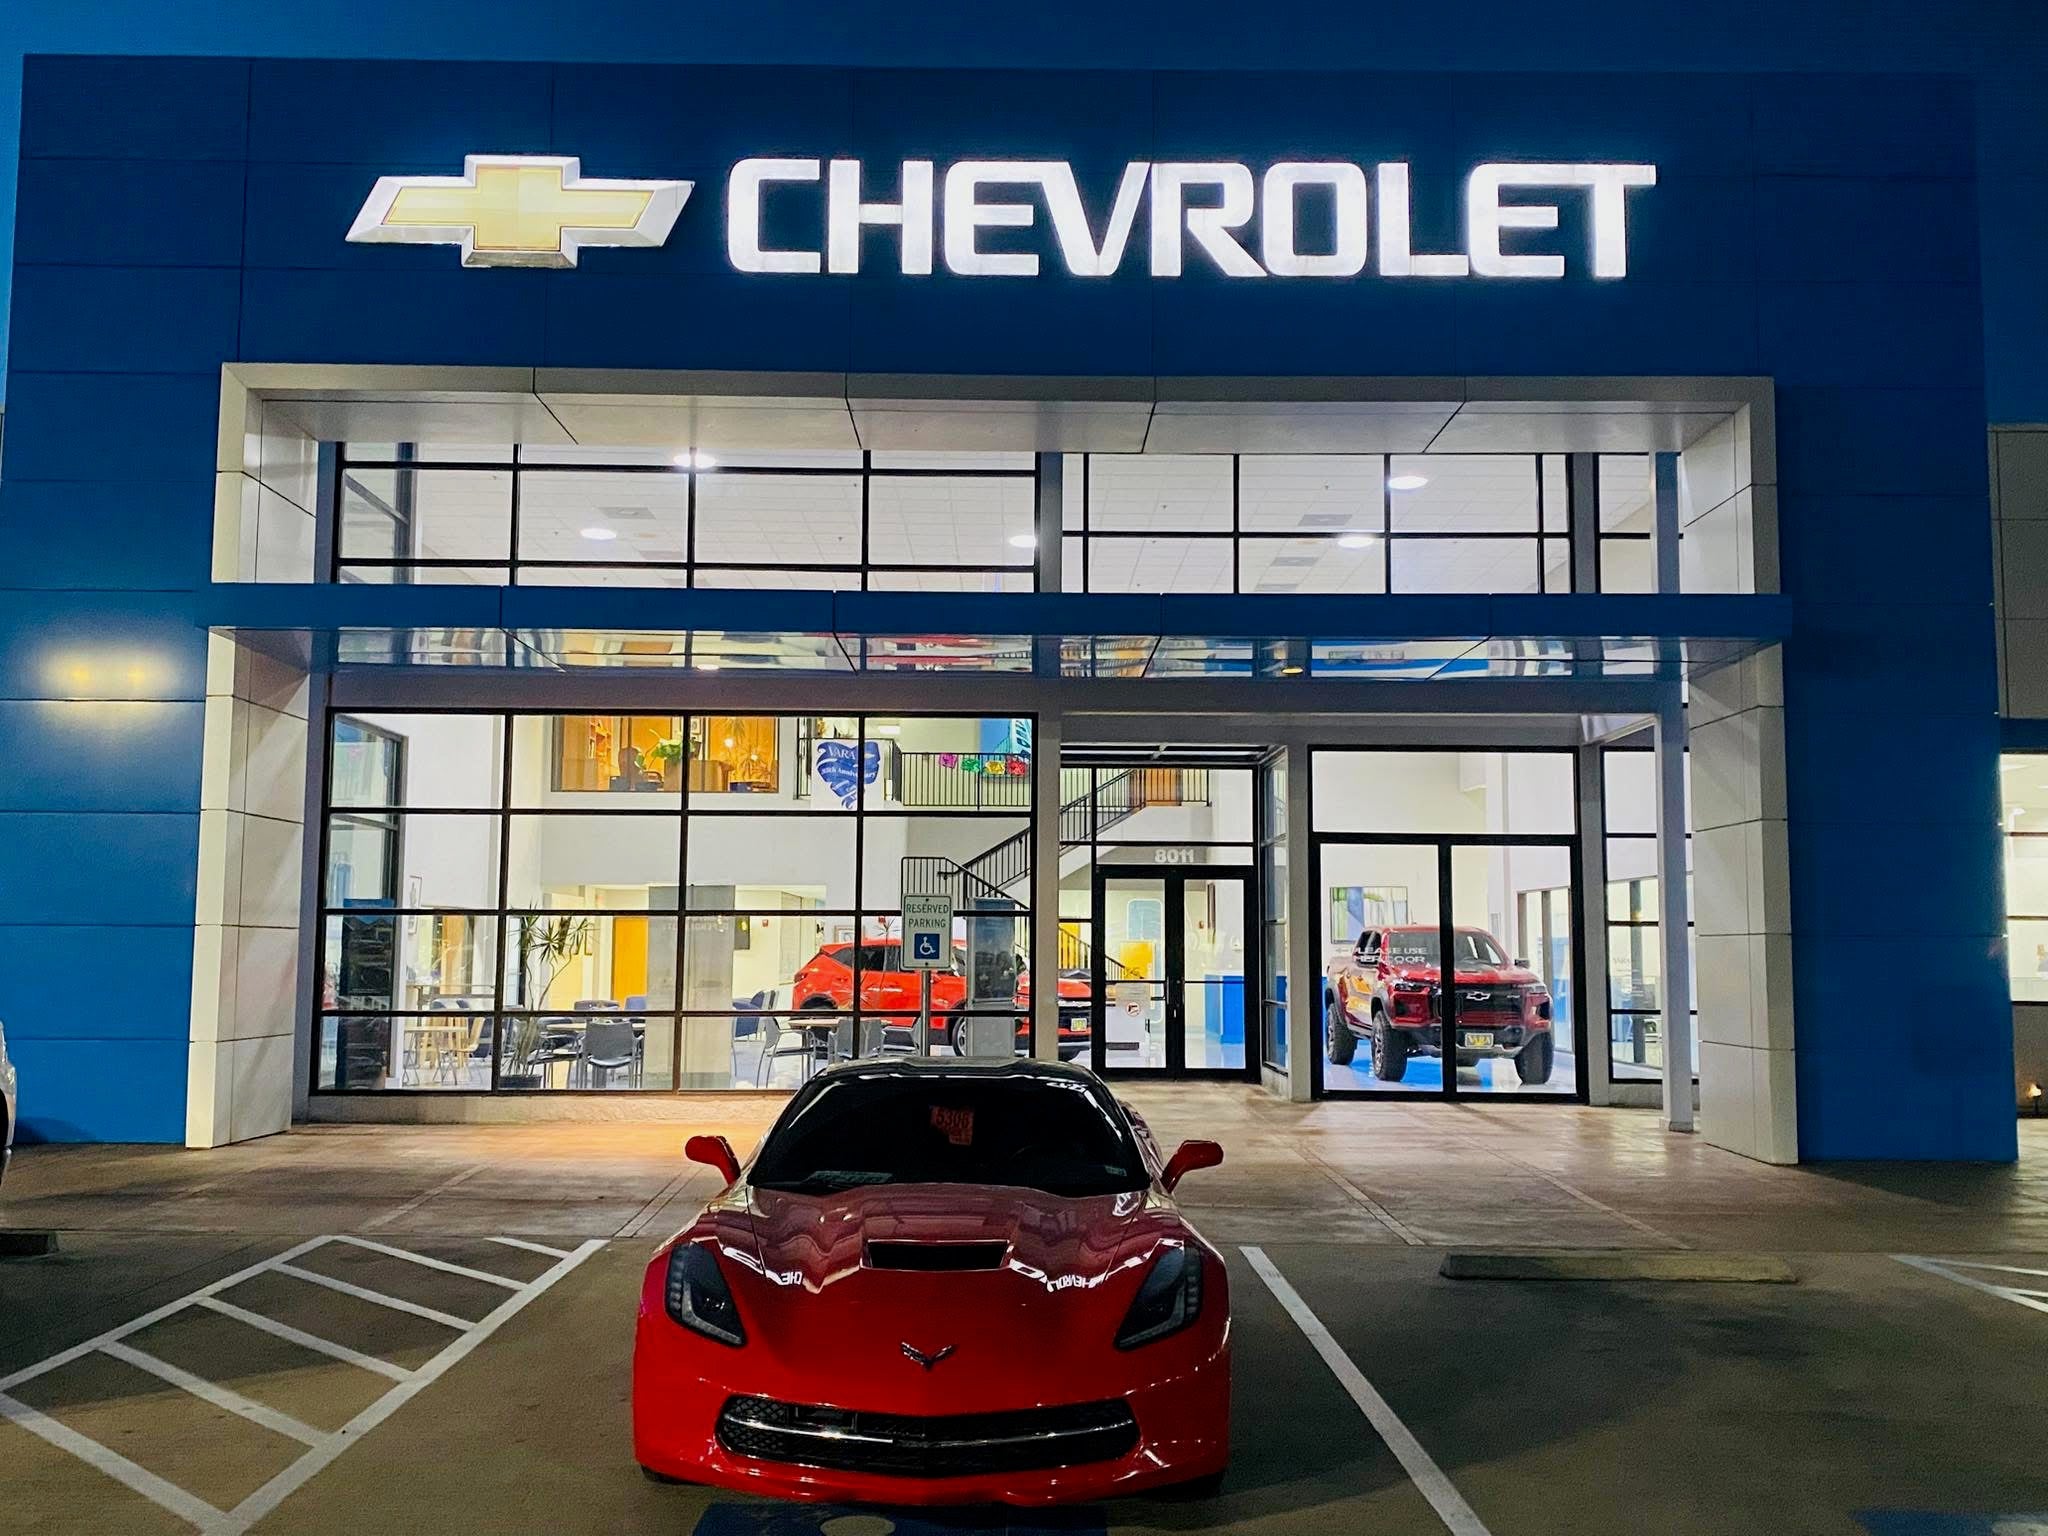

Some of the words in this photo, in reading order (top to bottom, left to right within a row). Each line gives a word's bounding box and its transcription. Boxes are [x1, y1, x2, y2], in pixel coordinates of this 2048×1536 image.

[727, 158, 1657, 279] CHEVROLET
[828, 744, 856, 760] VARA
[1154, 848, 1194, 863] 8011
[906, 903, 949, 914] RESERVED
[908, 918, 946, 928] PARKING
